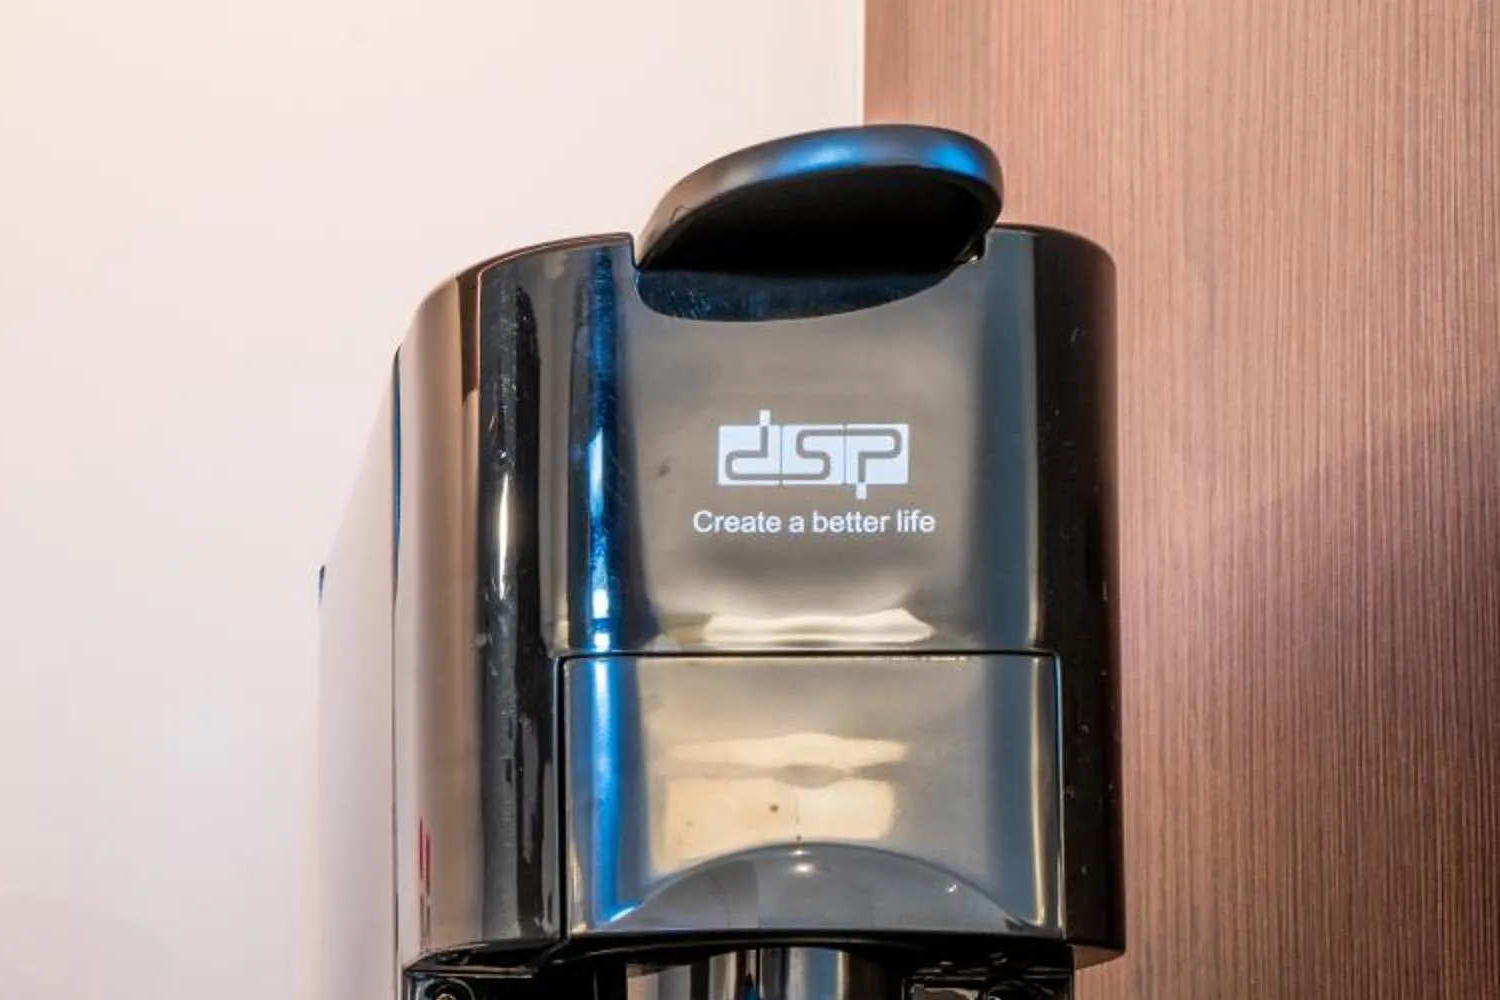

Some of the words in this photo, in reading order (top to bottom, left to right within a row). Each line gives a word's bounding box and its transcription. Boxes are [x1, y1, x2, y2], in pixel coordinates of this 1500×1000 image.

[693, 510, 782, 534] Create
[789, 515, 804, 534] a
[812, 510, 890, 534] better
[897, 509, 936, 534] life
